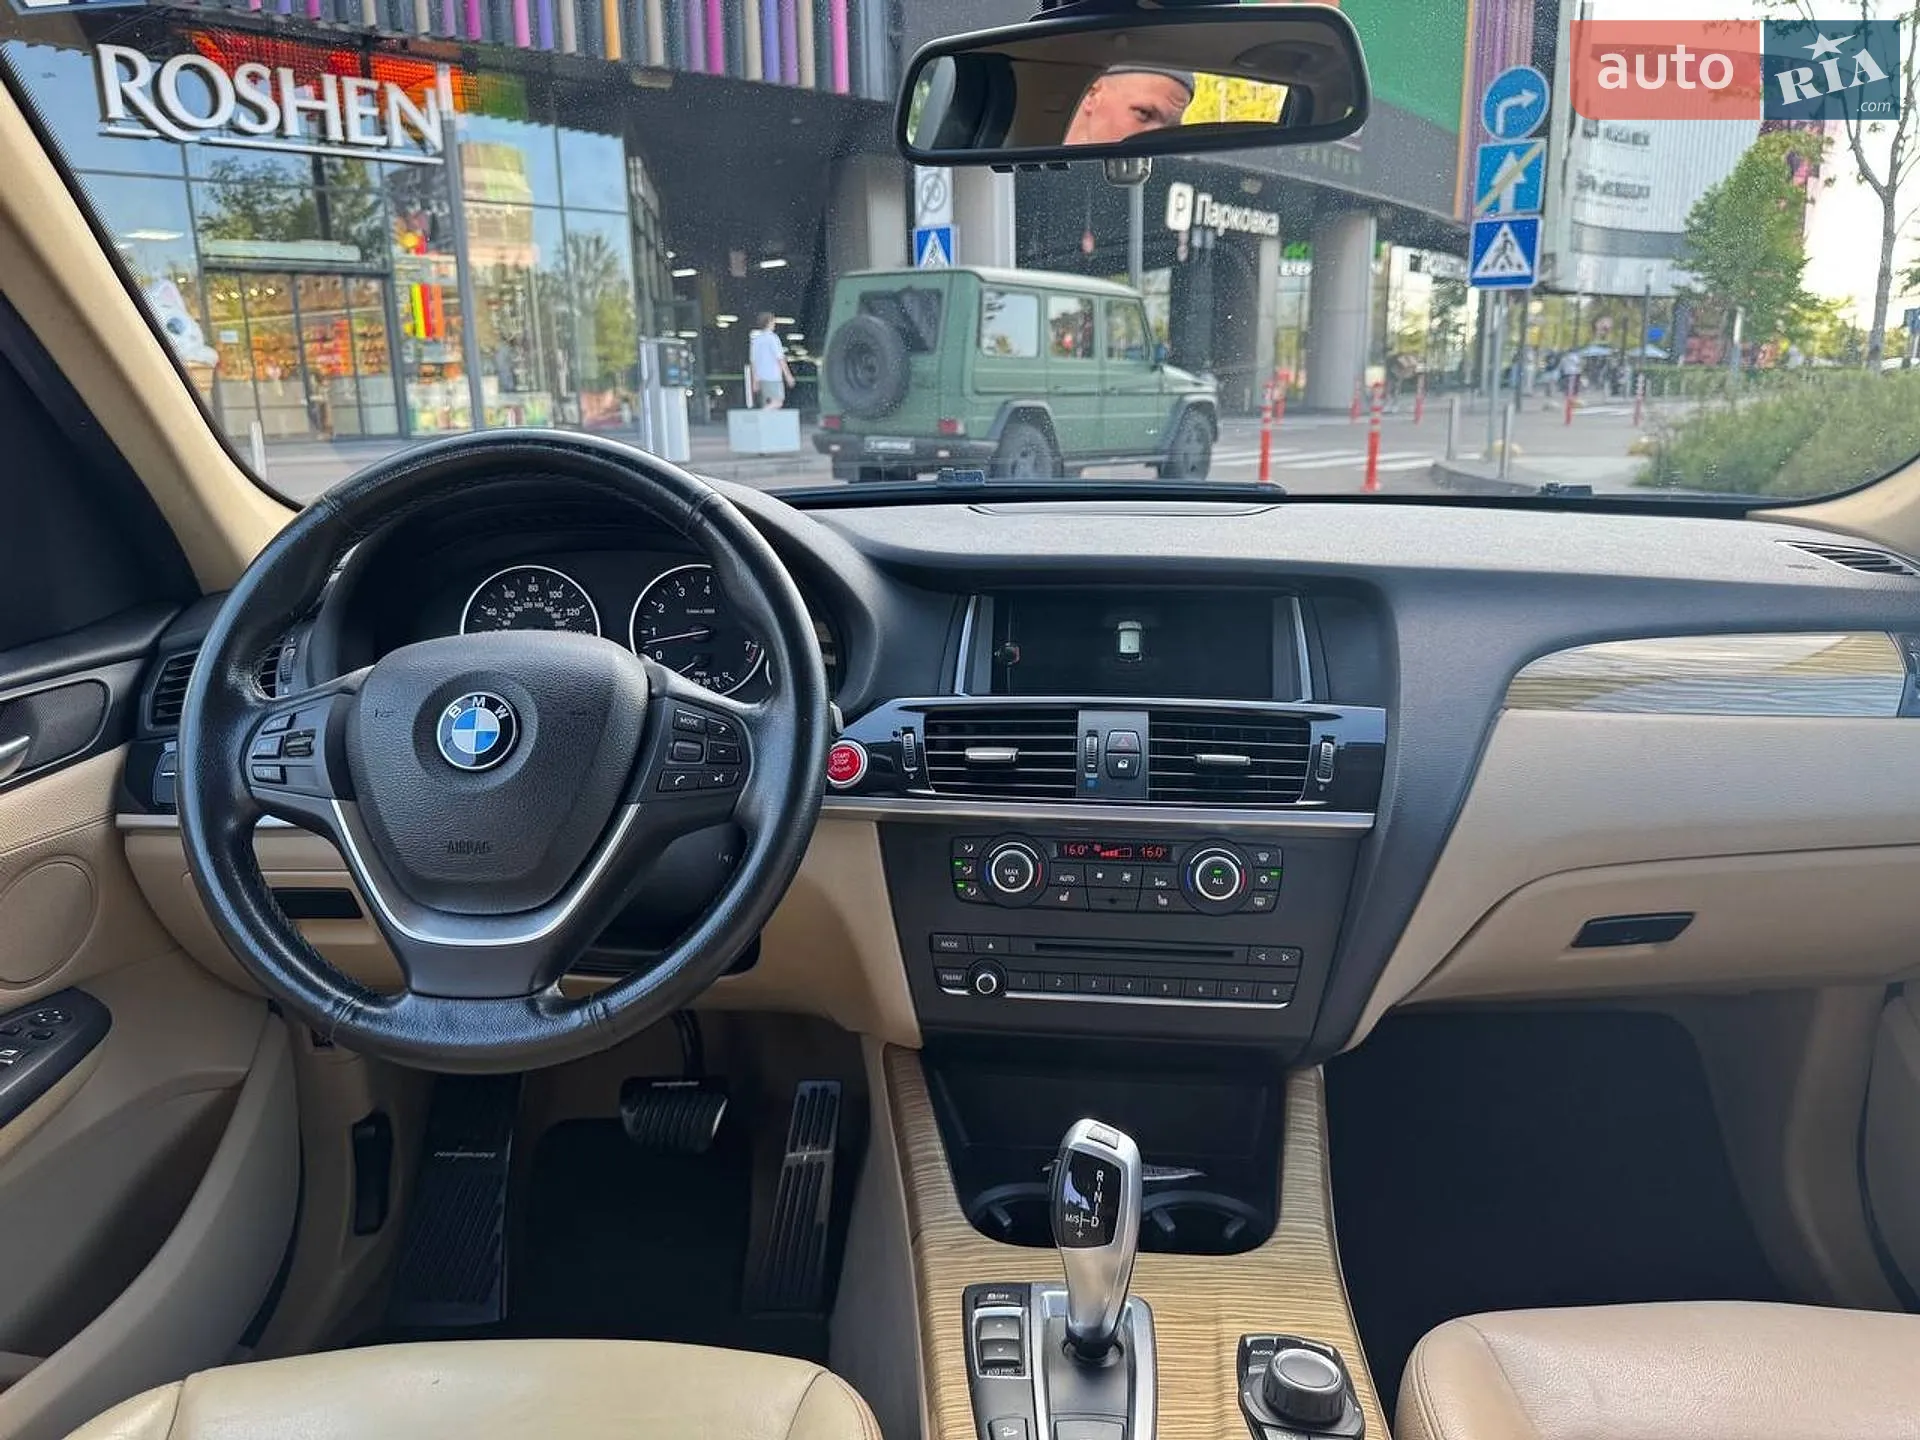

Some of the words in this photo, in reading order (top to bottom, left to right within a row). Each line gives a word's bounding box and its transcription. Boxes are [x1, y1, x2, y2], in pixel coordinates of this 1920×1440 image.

[97, 43, 444, 154] ROSHEN
[1195, 192, 1280, 236] Парковка
[679, 587, 686, 597] 3
[658, 603, 665, 613] 2
[655, 650, 663, 660] 0
[448, 696, 509, 719] BMW
[1096, 1170, 1104, 1181] R
[1093, 1191, 1103, 1203] N
[1091, 1216, 1100, 1227] D
